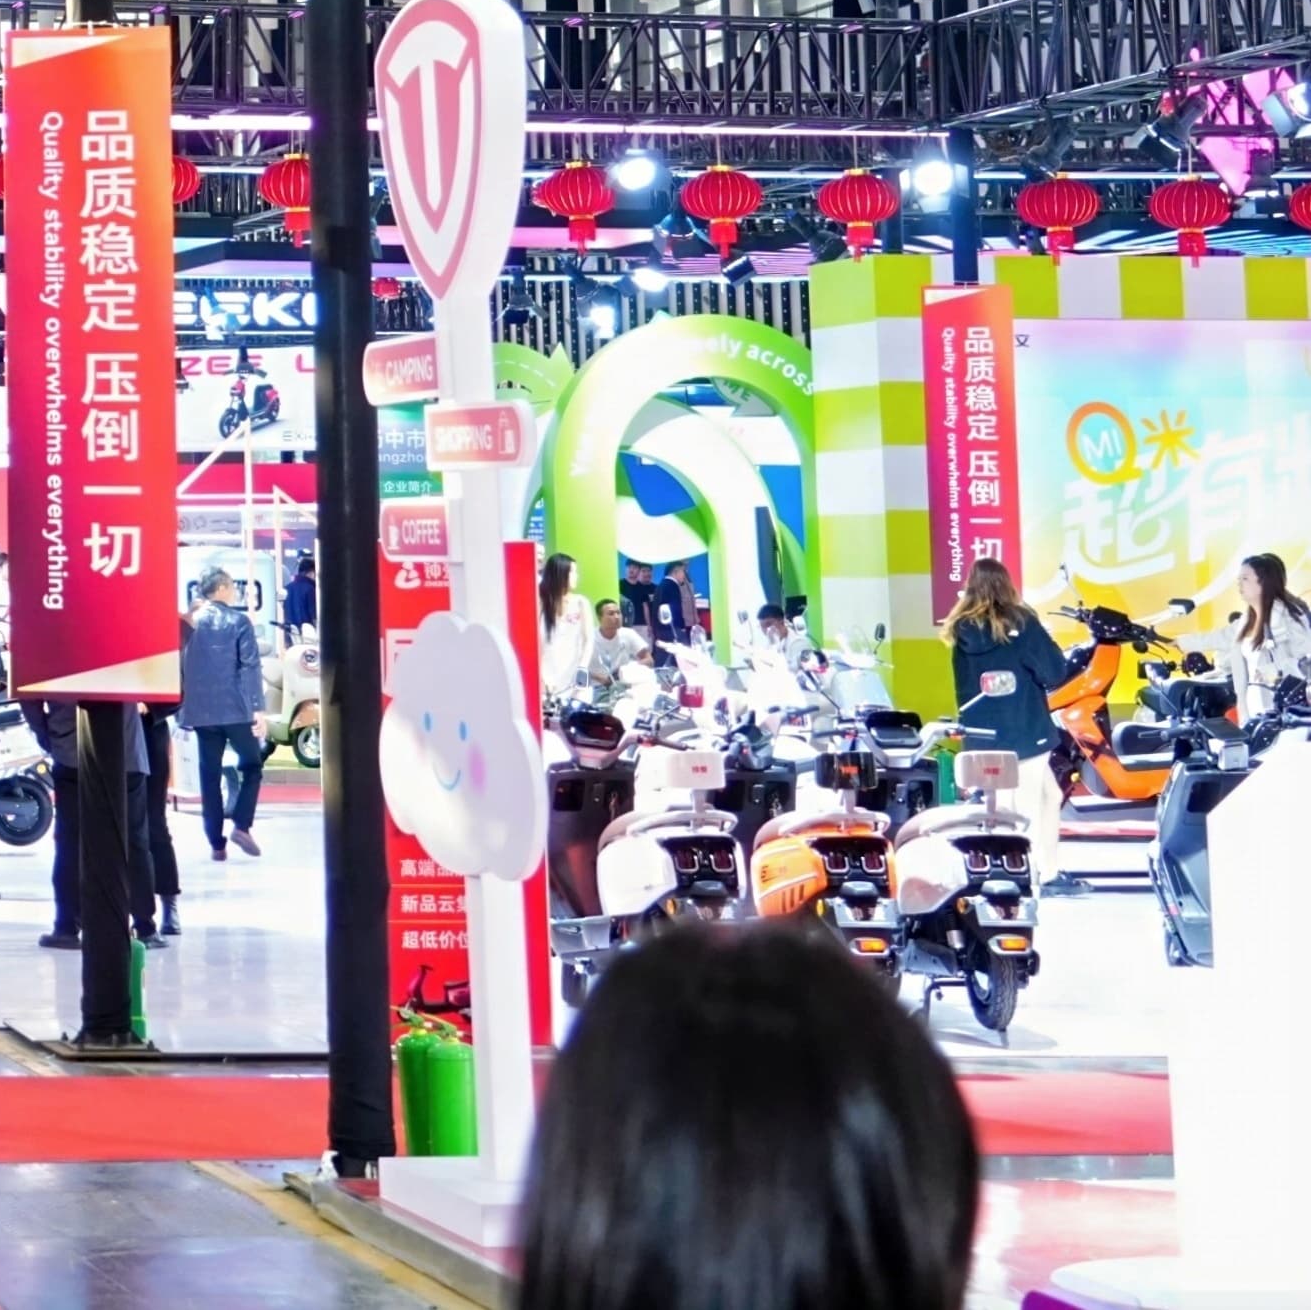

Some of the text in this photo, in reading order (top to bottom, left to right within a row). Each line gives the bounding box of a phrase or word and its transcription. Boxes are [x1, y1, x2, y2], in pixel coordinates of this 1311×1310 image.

[79, 110, 142, 577] 品质稳定 压倒一切
[39, 111, 70, 610] Quality stability overwhelms everything
[385, 354, 433, 387] CAMPING
[435, 425, 494, 453] SHOPPING
[941, 327, 965, 582] Quality stability overwhelms everything
[384, 480, 432, 494] 企业简介
[401, 519, 441, 544] COFFEE
